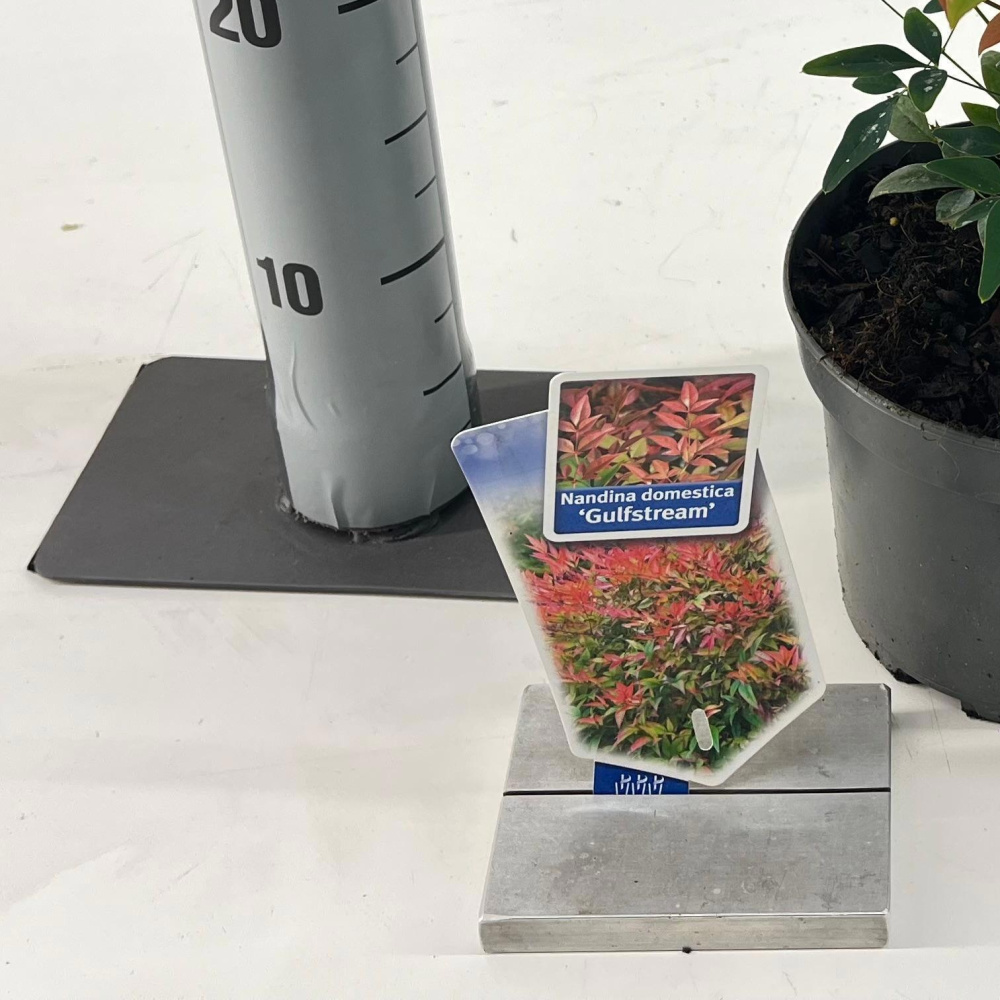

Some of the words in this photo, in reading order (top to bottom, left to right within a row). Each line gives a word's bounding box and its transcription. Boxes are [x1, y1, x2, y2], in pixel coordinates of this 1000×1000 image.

[256, 255, 324, 317] 10
[560, 489, 637, 506] Nandina
[640, 484, 735, 502] domestica
